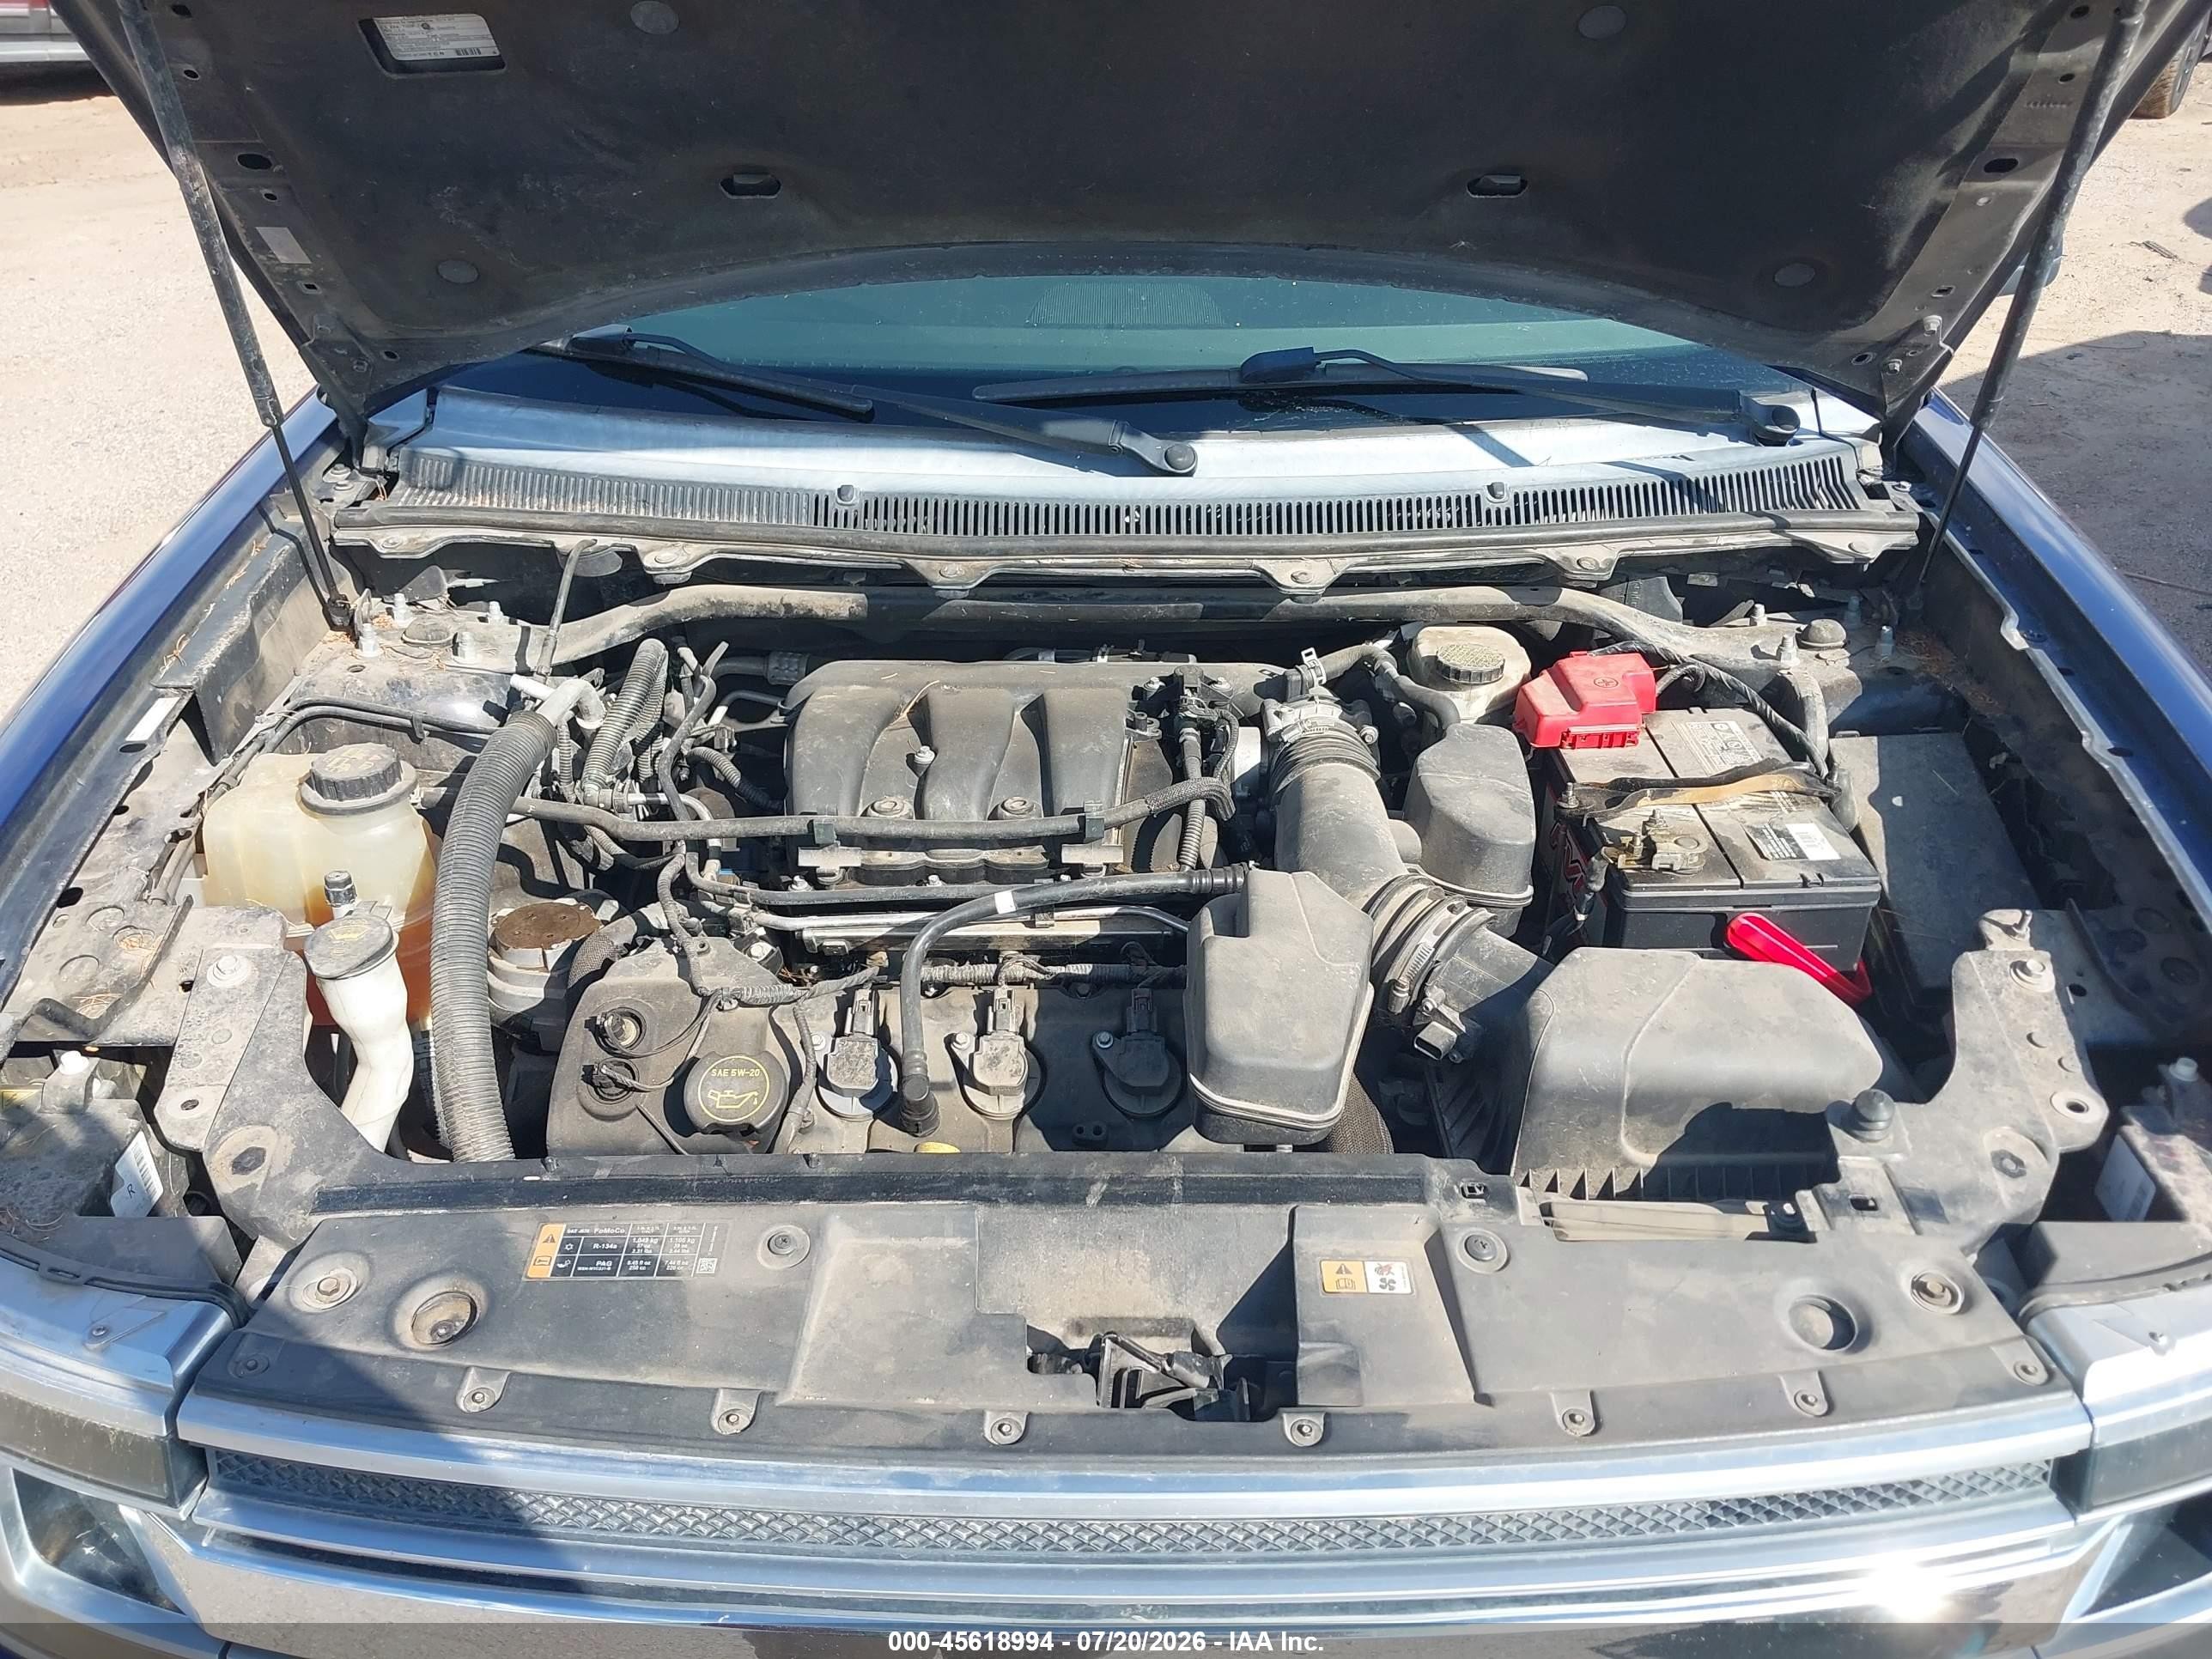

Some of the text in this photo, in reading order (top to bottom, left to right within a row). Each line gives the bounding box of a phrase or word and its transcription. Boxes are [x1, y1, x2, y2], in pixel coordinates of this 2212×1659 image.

[711, 1068, 761, 1077] SAE 5W-20
[126, 1183, 136, 1199] R
